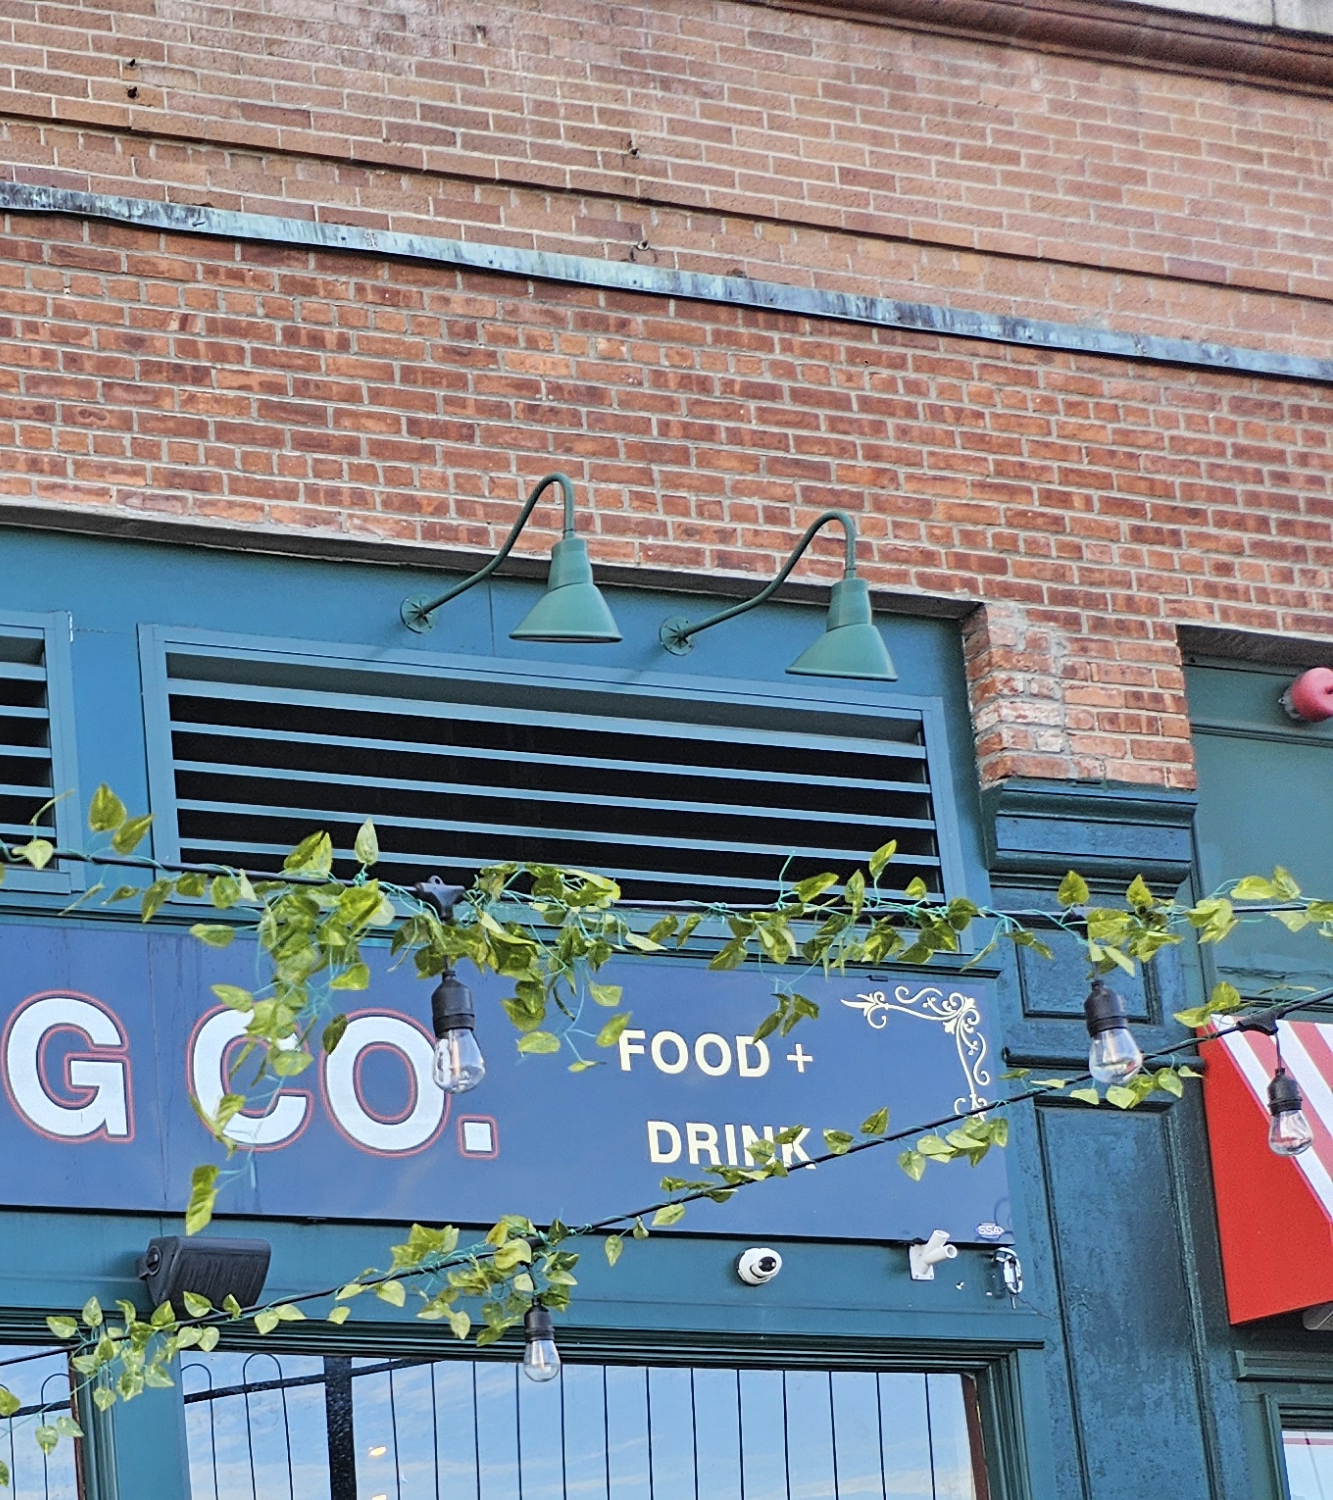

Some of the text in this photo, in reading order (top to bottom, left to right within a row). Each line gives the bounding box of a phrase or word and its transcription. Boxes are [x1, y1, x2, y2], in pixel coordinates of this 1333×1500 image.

[618, 1029, 771, 1078] FOOD
[186, 1001, 500, 1160] CO.
[647, 1120, 817, 1170] DRINK
